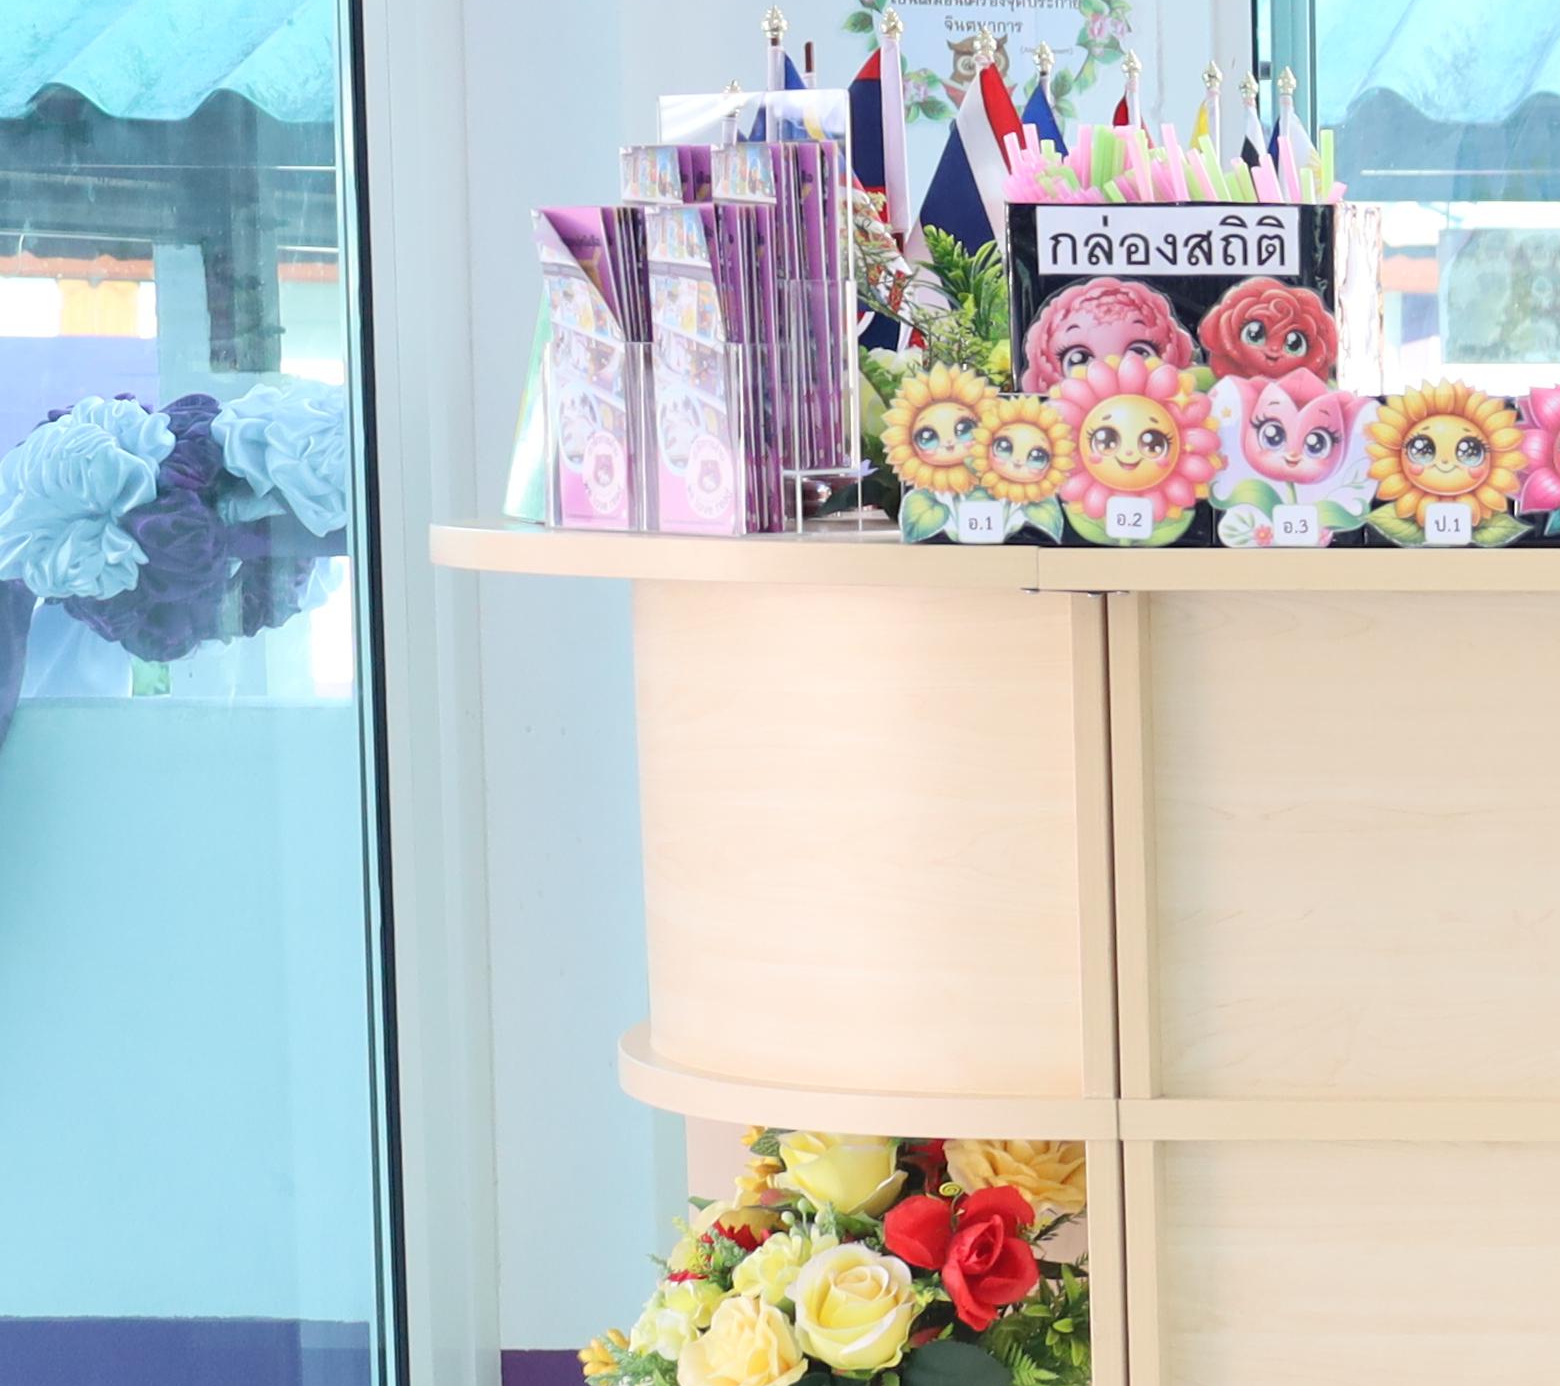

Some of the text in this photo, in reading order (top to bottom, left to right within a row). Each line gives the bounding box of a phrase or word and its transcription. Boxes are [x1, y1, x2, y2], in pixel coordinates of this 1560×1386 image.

[1049, 215, 1285, 266] กล่องสถิติ
[968, 517, 993, 531] อ.1
[1116, 512, 1143, 527] อ.2
[1283, 519, 1309, 534] อ.3
[1434, 516, 1460, 533] ป.1
